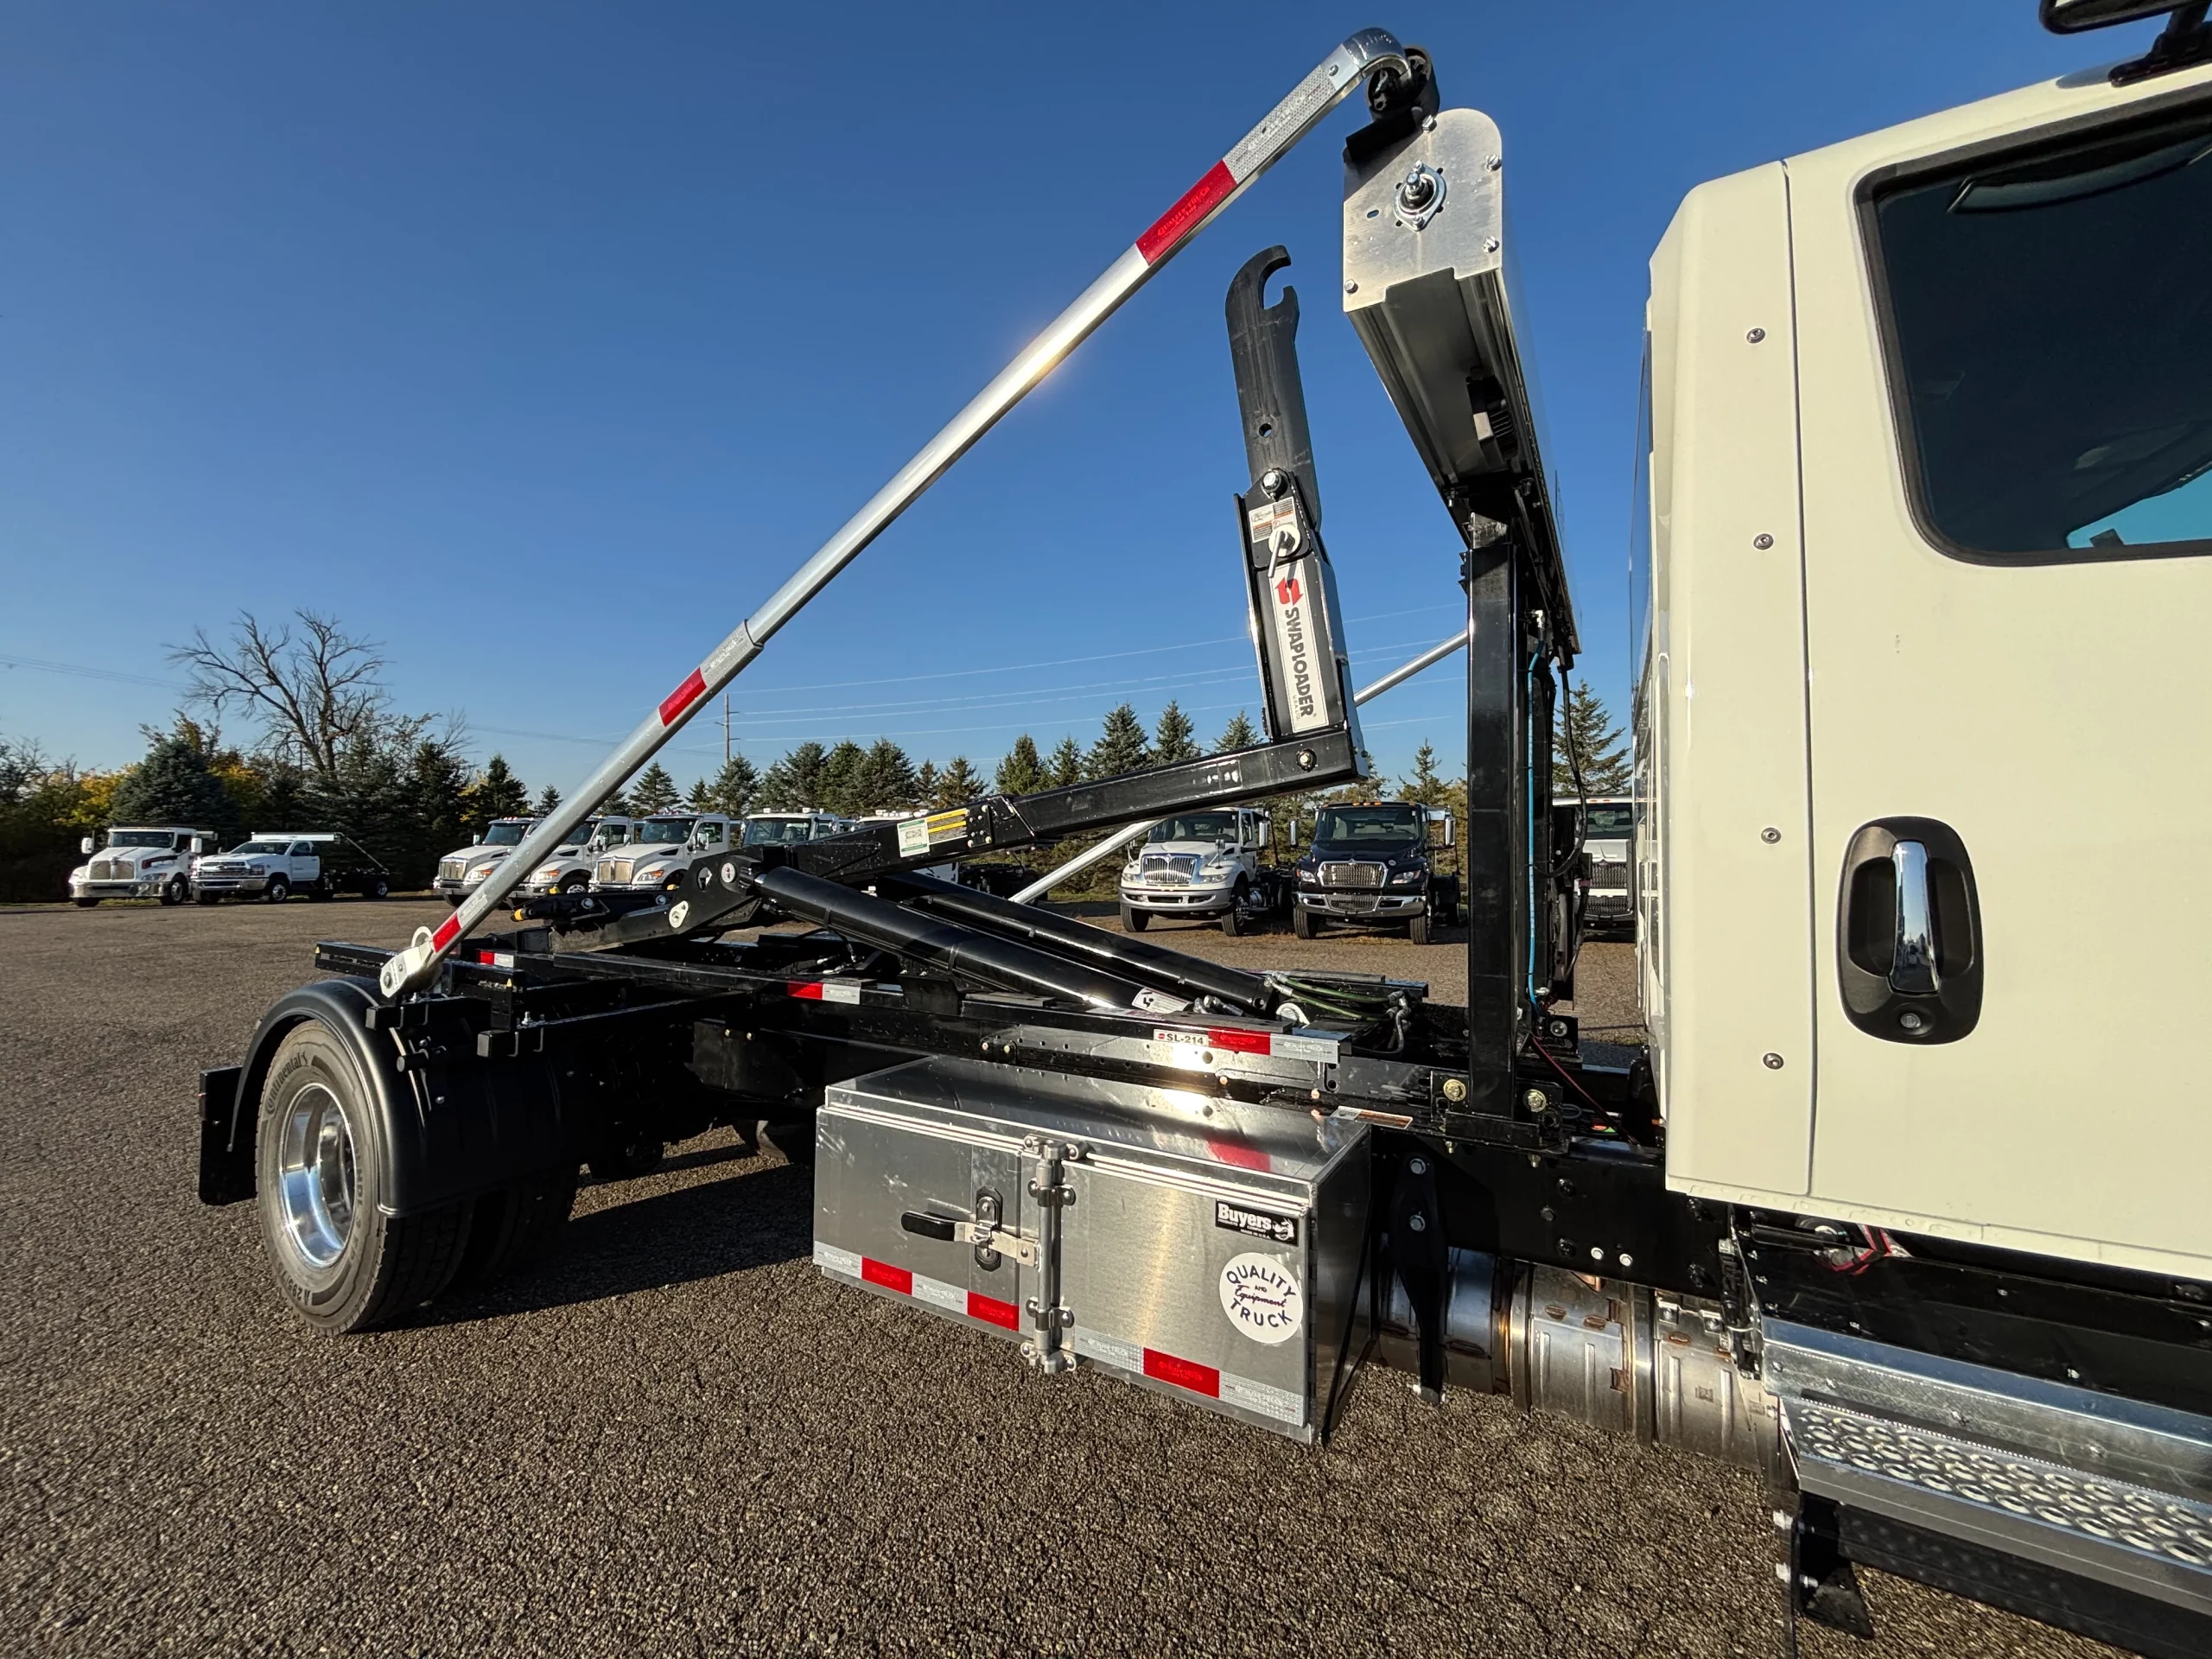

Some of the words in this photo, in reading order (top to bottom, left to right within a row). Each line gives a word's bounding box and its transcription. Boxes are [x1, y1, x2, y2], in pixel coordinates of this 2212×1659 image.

[1285, 607, 1314, 717] SWAPLOADER
[1166, 1033, 1204, 1045] SL-214
[264, 1052, 302, 1115] Continental
[1217, 1203, 1272, 1230] Buyers
[1226, 1264, 1297, 1298] QUALITY
[1235, 1284, 1287, 1308] Equipment
[1230, 1298, 1293, 1328] TRUCK
